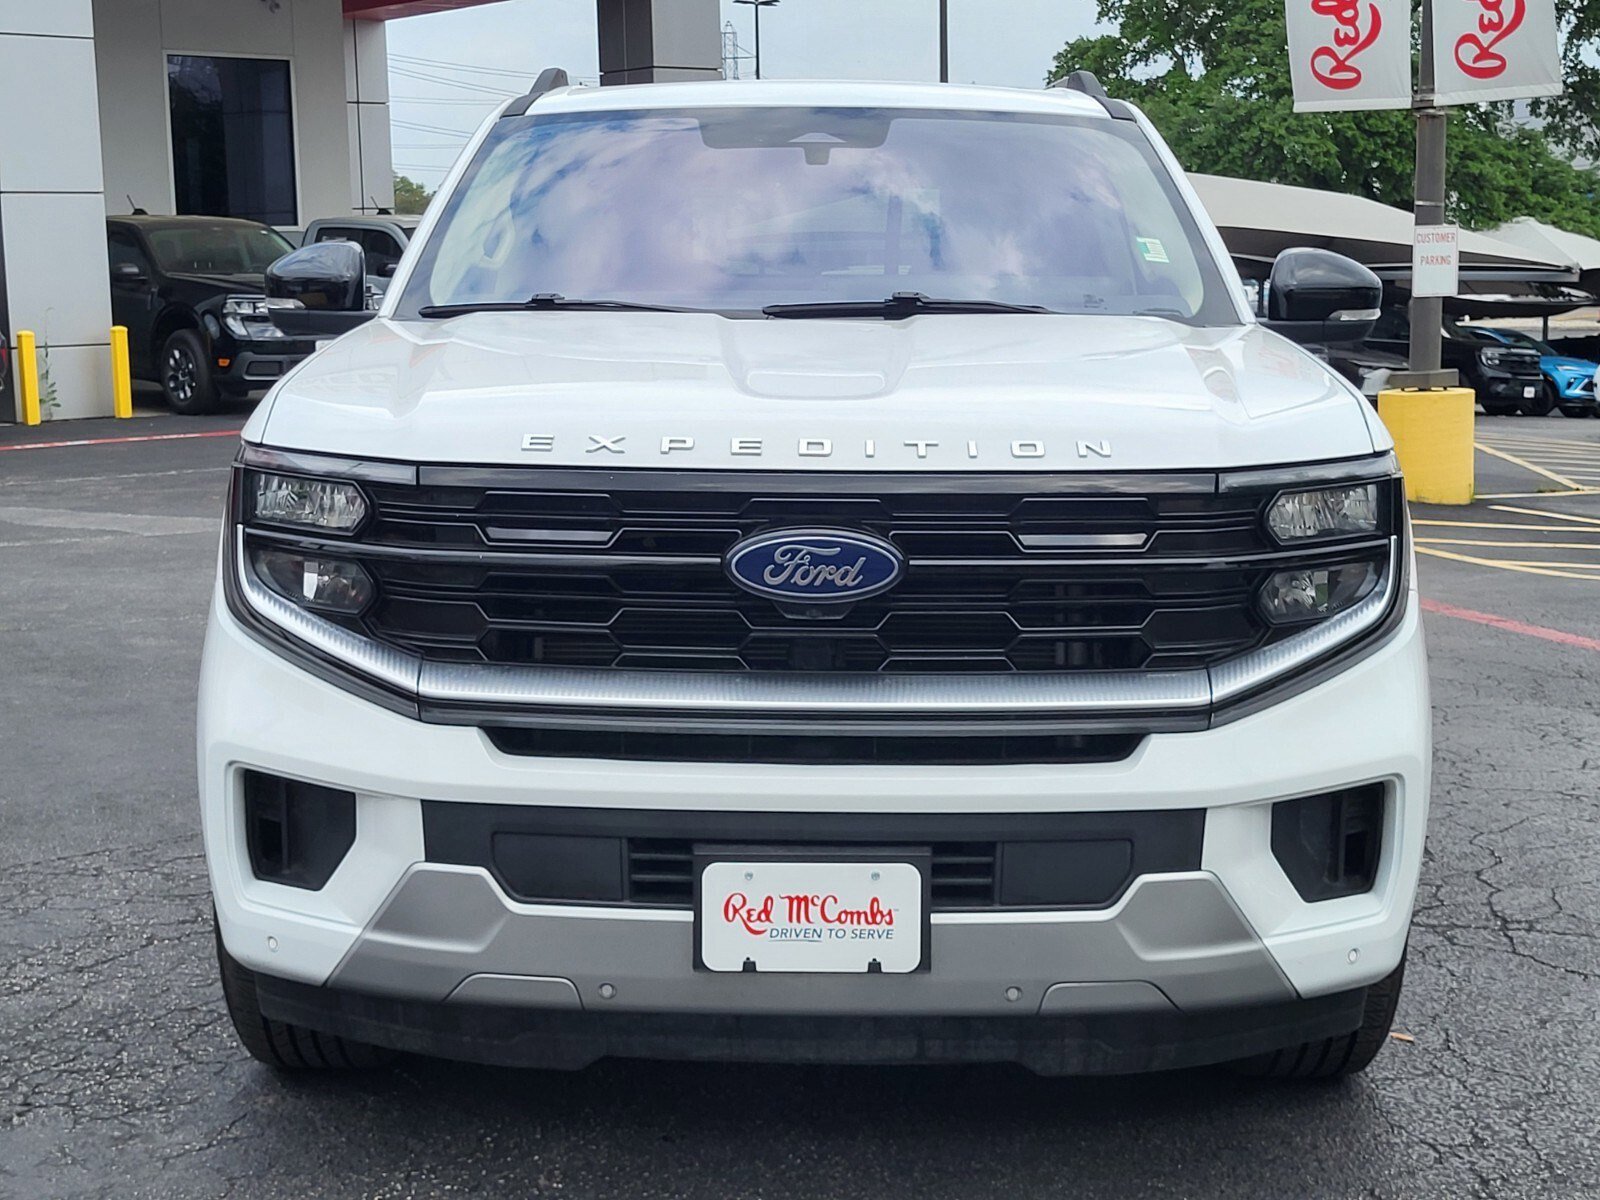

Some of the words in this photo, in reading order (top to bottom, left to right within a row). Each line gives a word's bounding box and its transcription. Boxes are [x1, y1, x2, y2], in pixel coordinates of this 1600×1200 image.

[1454, 0, 1526, 79] Re
[1416, 232, 1456, 244] CUSTOMER
[1420, 255, 1452, 266] PARKING
[520, 433, 1112, 459] EXPEDITION
[763, 544, 864, 588] Ford
[723, 892, 774, 936] Red
[778, 894, 894, 926] McCombs
[769, 927, 823, 939] DRIVEN
[827, 928, 847, 939] TO
[850, 928, 895, 940] SERVE
